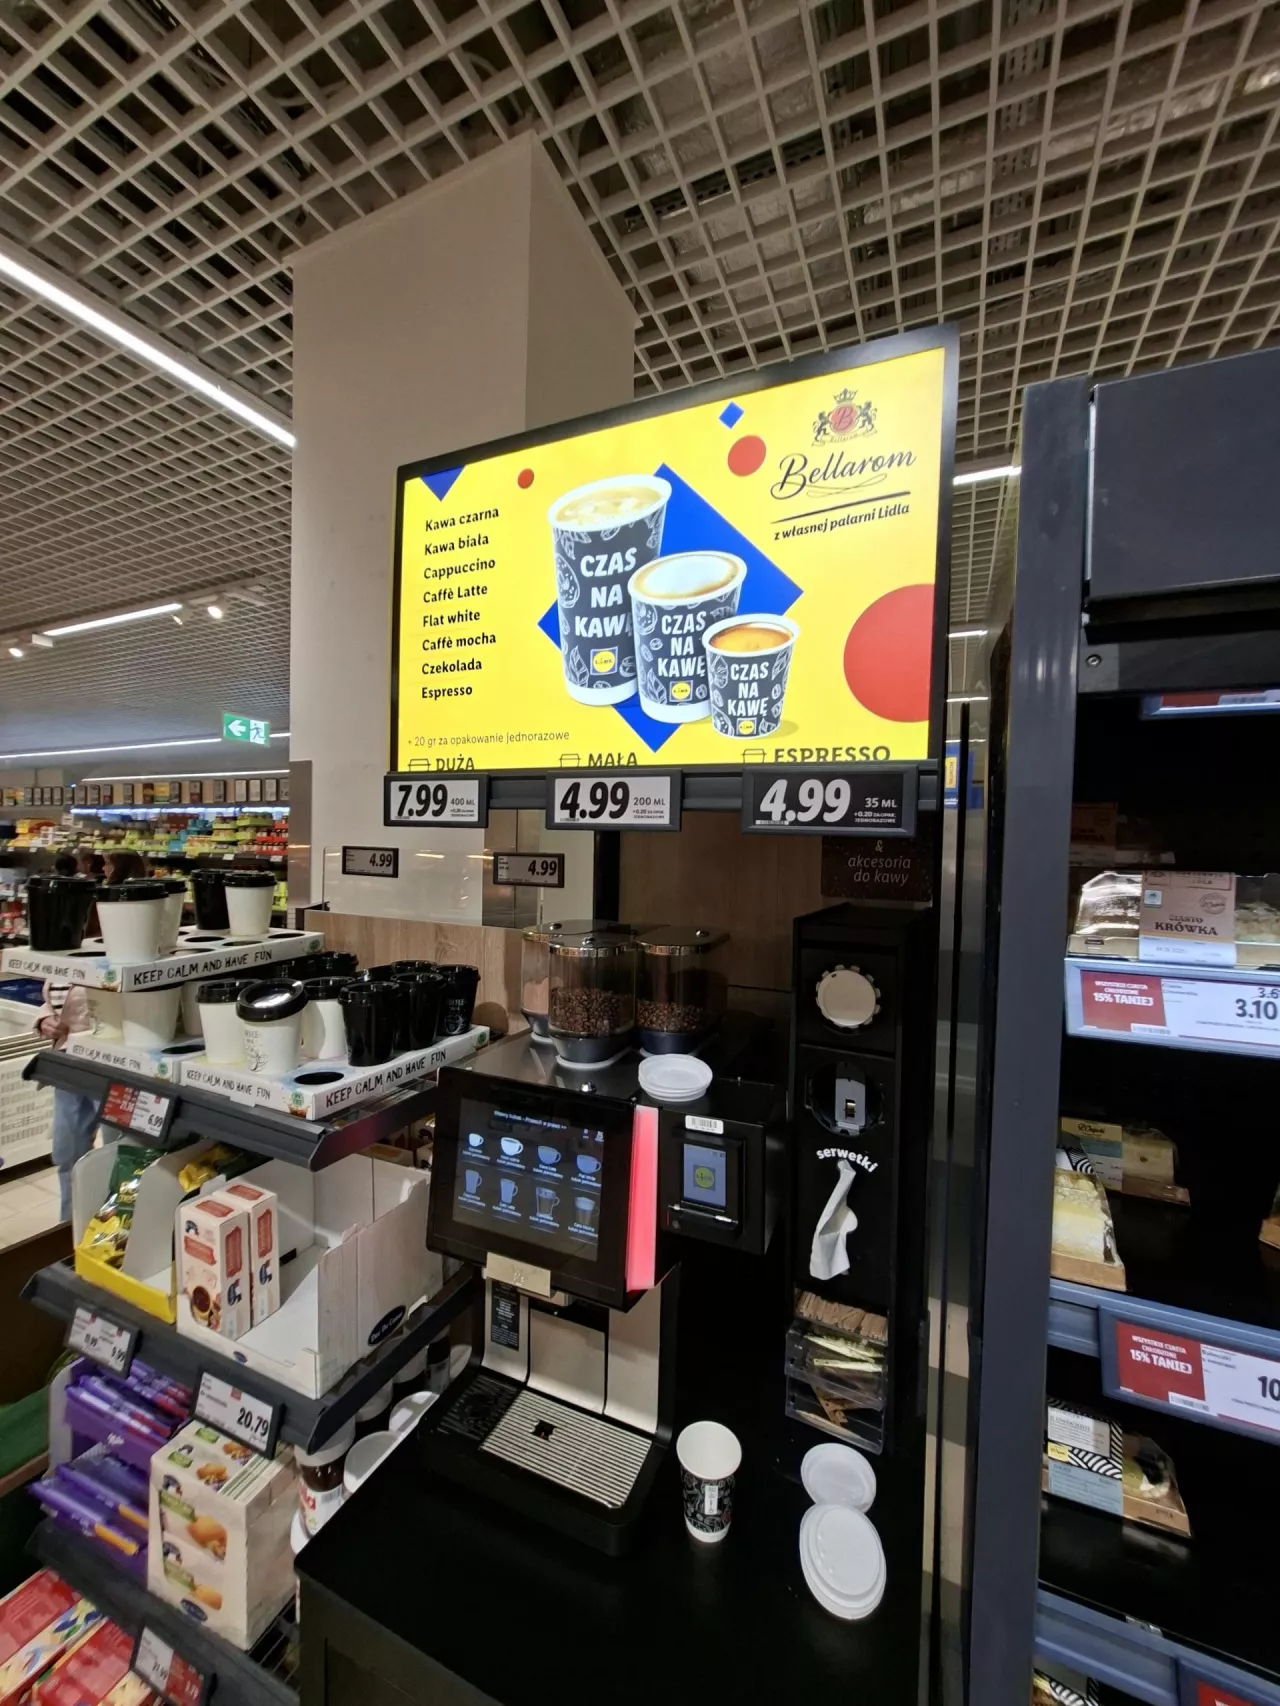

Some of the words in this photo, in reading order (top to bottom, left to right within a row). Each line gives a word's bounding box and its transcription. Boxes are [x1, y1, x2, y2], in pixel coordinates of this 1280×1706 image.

[770, 451, 917, 500] Bellarom
[425, 517, 456, 532] Kawa
[459, 508, 499, 525] czarna
[774, 532, 780, 541] z
[782, 519, 828, 540] własnej
[830, 509, 875, 532] palarni
[878, 504, 910, 520] Lidla
[424, 541, 455, 556] Kawa
[458, 532, 489, 549] biała
[424, 557, 496, 580] Cappuccino
[580, 547, 638, 577] CZAS
[423, 588, 454, 603] Caffè
[458, 585, 488, 599] Latte
[590, 584, 623, 608] NA
[423, 614, 444, 627] Flat
[447, 609, 481, 624] white
[661, 611, 707, 635] CZAS
[422, 636, 453, 651] Caffè
[456, 632, 496, 647] mocha
[670, 636, 695, 656] NA
[421, 658, 482, 675] Czekolada
[730, 661, 769, 681] CZAS
[421, 686, 473, 701] Espresso
[738, 682, 759, 699] NA
[727, 697, 769, 717] KAWĘ
[414, 736, 426, 747] 20
[427, 738, 436, 749] gr
[438, 737, 448, 746] za
[450, 733, 504, 747] opakowanie
[505, 731, 570, 745] jednorazowe
[436, 753, 475, 771] DUŻA
[588, 751, 639, 767] MAŁA
[774, 745, 891, 764] ESPRESSO
[397, 784, 448, 817] 7.99
[450, 798, 465, 806] 400
[560, 781, 630, 819] 4.99
[633, 797, 652, 806] 200
[653, 798, 666, 806] ML
[760, 778, 851, 823] 4.99
[864, 797, 879, 808] 35
[881, 799, 898, 808] ML
[875, 839, 883, 853] &
[369, 853, 392, 867] 4.99
[527, 860, 558, 876] 4.99
[847, 854, 911, 869] akcesoria
[853, 868, 870, 882] do
[874, 868, 909, 887] kawy
[1154, 921, 1218, 936] KRÓWKA
[133, 970, 163, 985] KEEP
[167, 962, 198, 979] CALM
[202, 960, 222, 972] AND
[225, 953, 249, 968] HAVE
[254, 949, 272, 963] FUN
[1235, 998, 1278, 1020] 3.10
[325, 1087, 352, 1108] KEEP
[355, 1074, 383, 1095] CALM
[386, 1067, 402, 1083] AND
[405, 1056, 426, 1076] HAVE
[431, 1048, 447, 1065] FUN
[222, 1079, 235, 1090] AND
[256, 1087, 271, 1100] FUN
[147, 1114, 164, 1128] 6.99
[816, 1148, 879, 1173] serwetki
[1130, 1348, 1151, 1364] 15%
[237, 1406, 269, 1437] 20.79
